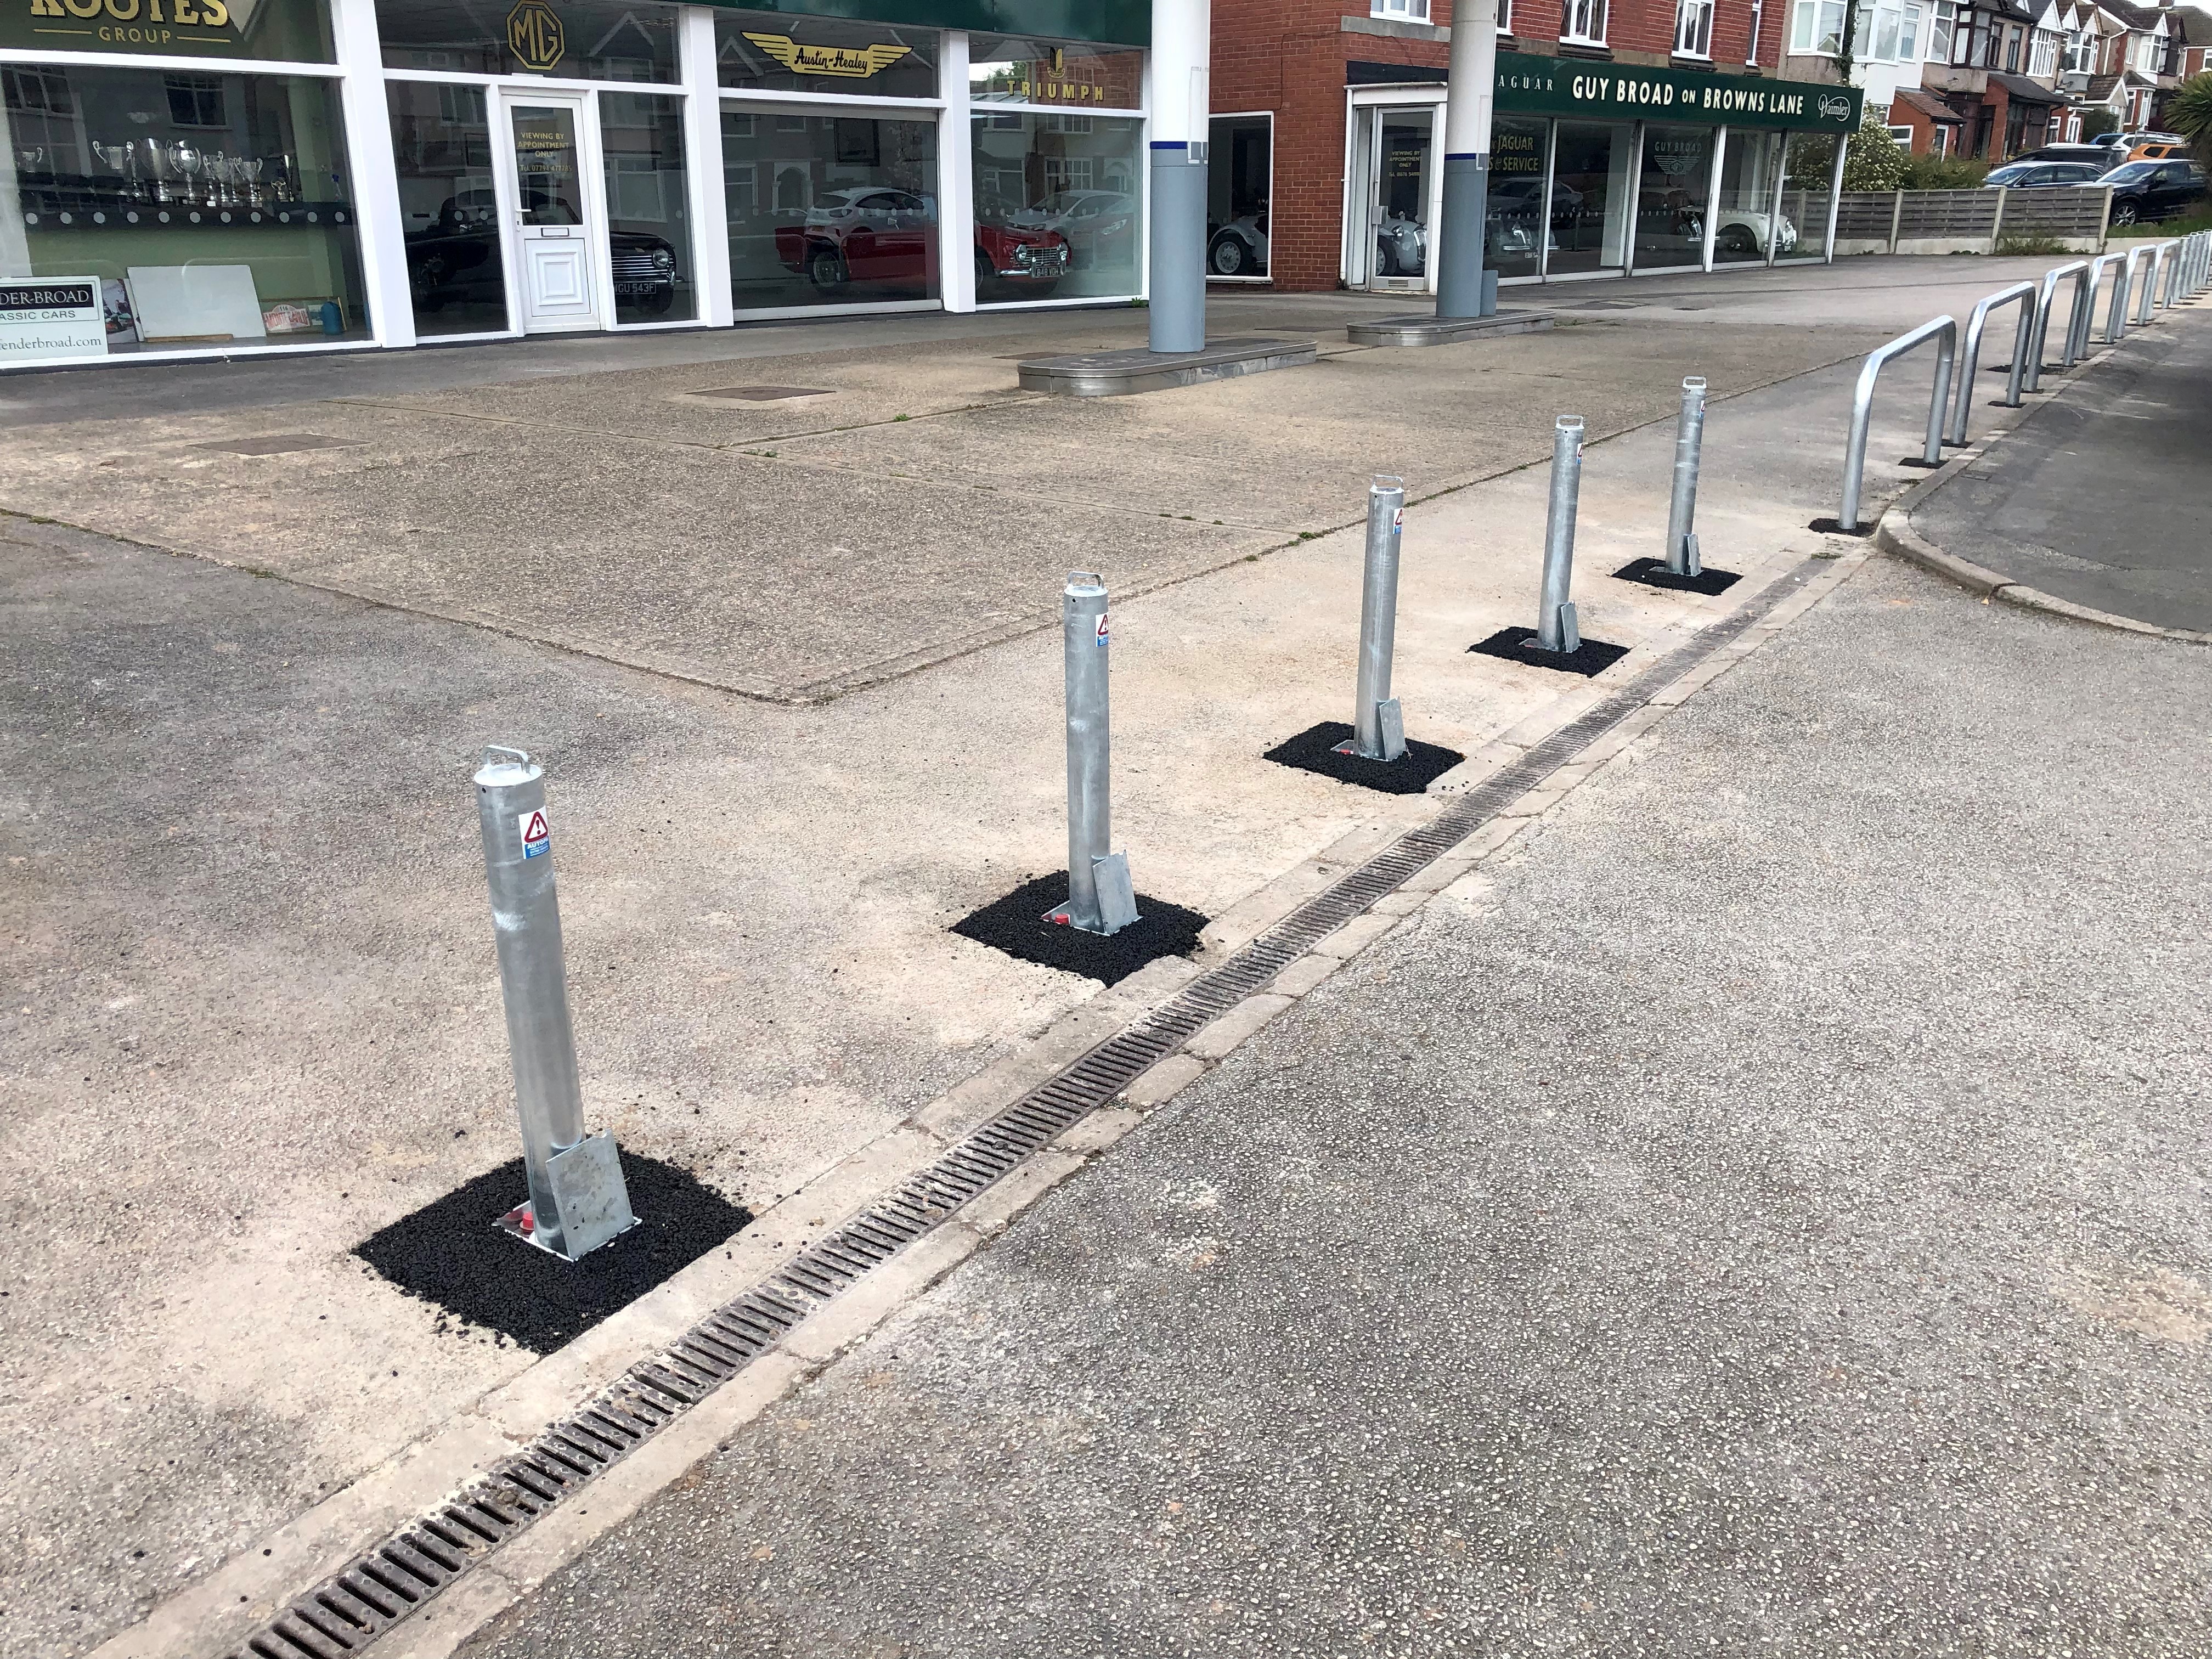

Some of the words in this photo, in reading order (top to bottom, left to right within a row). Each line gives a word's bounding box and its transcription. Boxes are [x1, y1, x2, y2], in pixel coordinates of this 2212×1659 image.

[98, 27, 171, 44] GROUP
[514, 8, 558, 62] MG
[794, 47, 868, 74] Austin-Healey
[1007, 80, 1104, 101] TRIUMPH
[1498, 75, 1553, 91] AGUAR
[1572, 75, 1610, 100] GUY
[1616, 79, 1673, 105] BROAD
[1681, 89, 1696, 104] ON
[1703, 87, 1765, 112] BROWNS
[1769, 93, 1804, 115] LANE
[1818, 94, 1850, 122] Daimler
[1497, 136, 1534, 154] JAGUAR
[1655, 141, 1671, 151] GUY
[1674, 142, 1702, 153] BROAD
[1502, 157, 1539, 171] SERVICE
[632, 283, 655, 293] 543F
[41, 310, 76, 319] CARS
